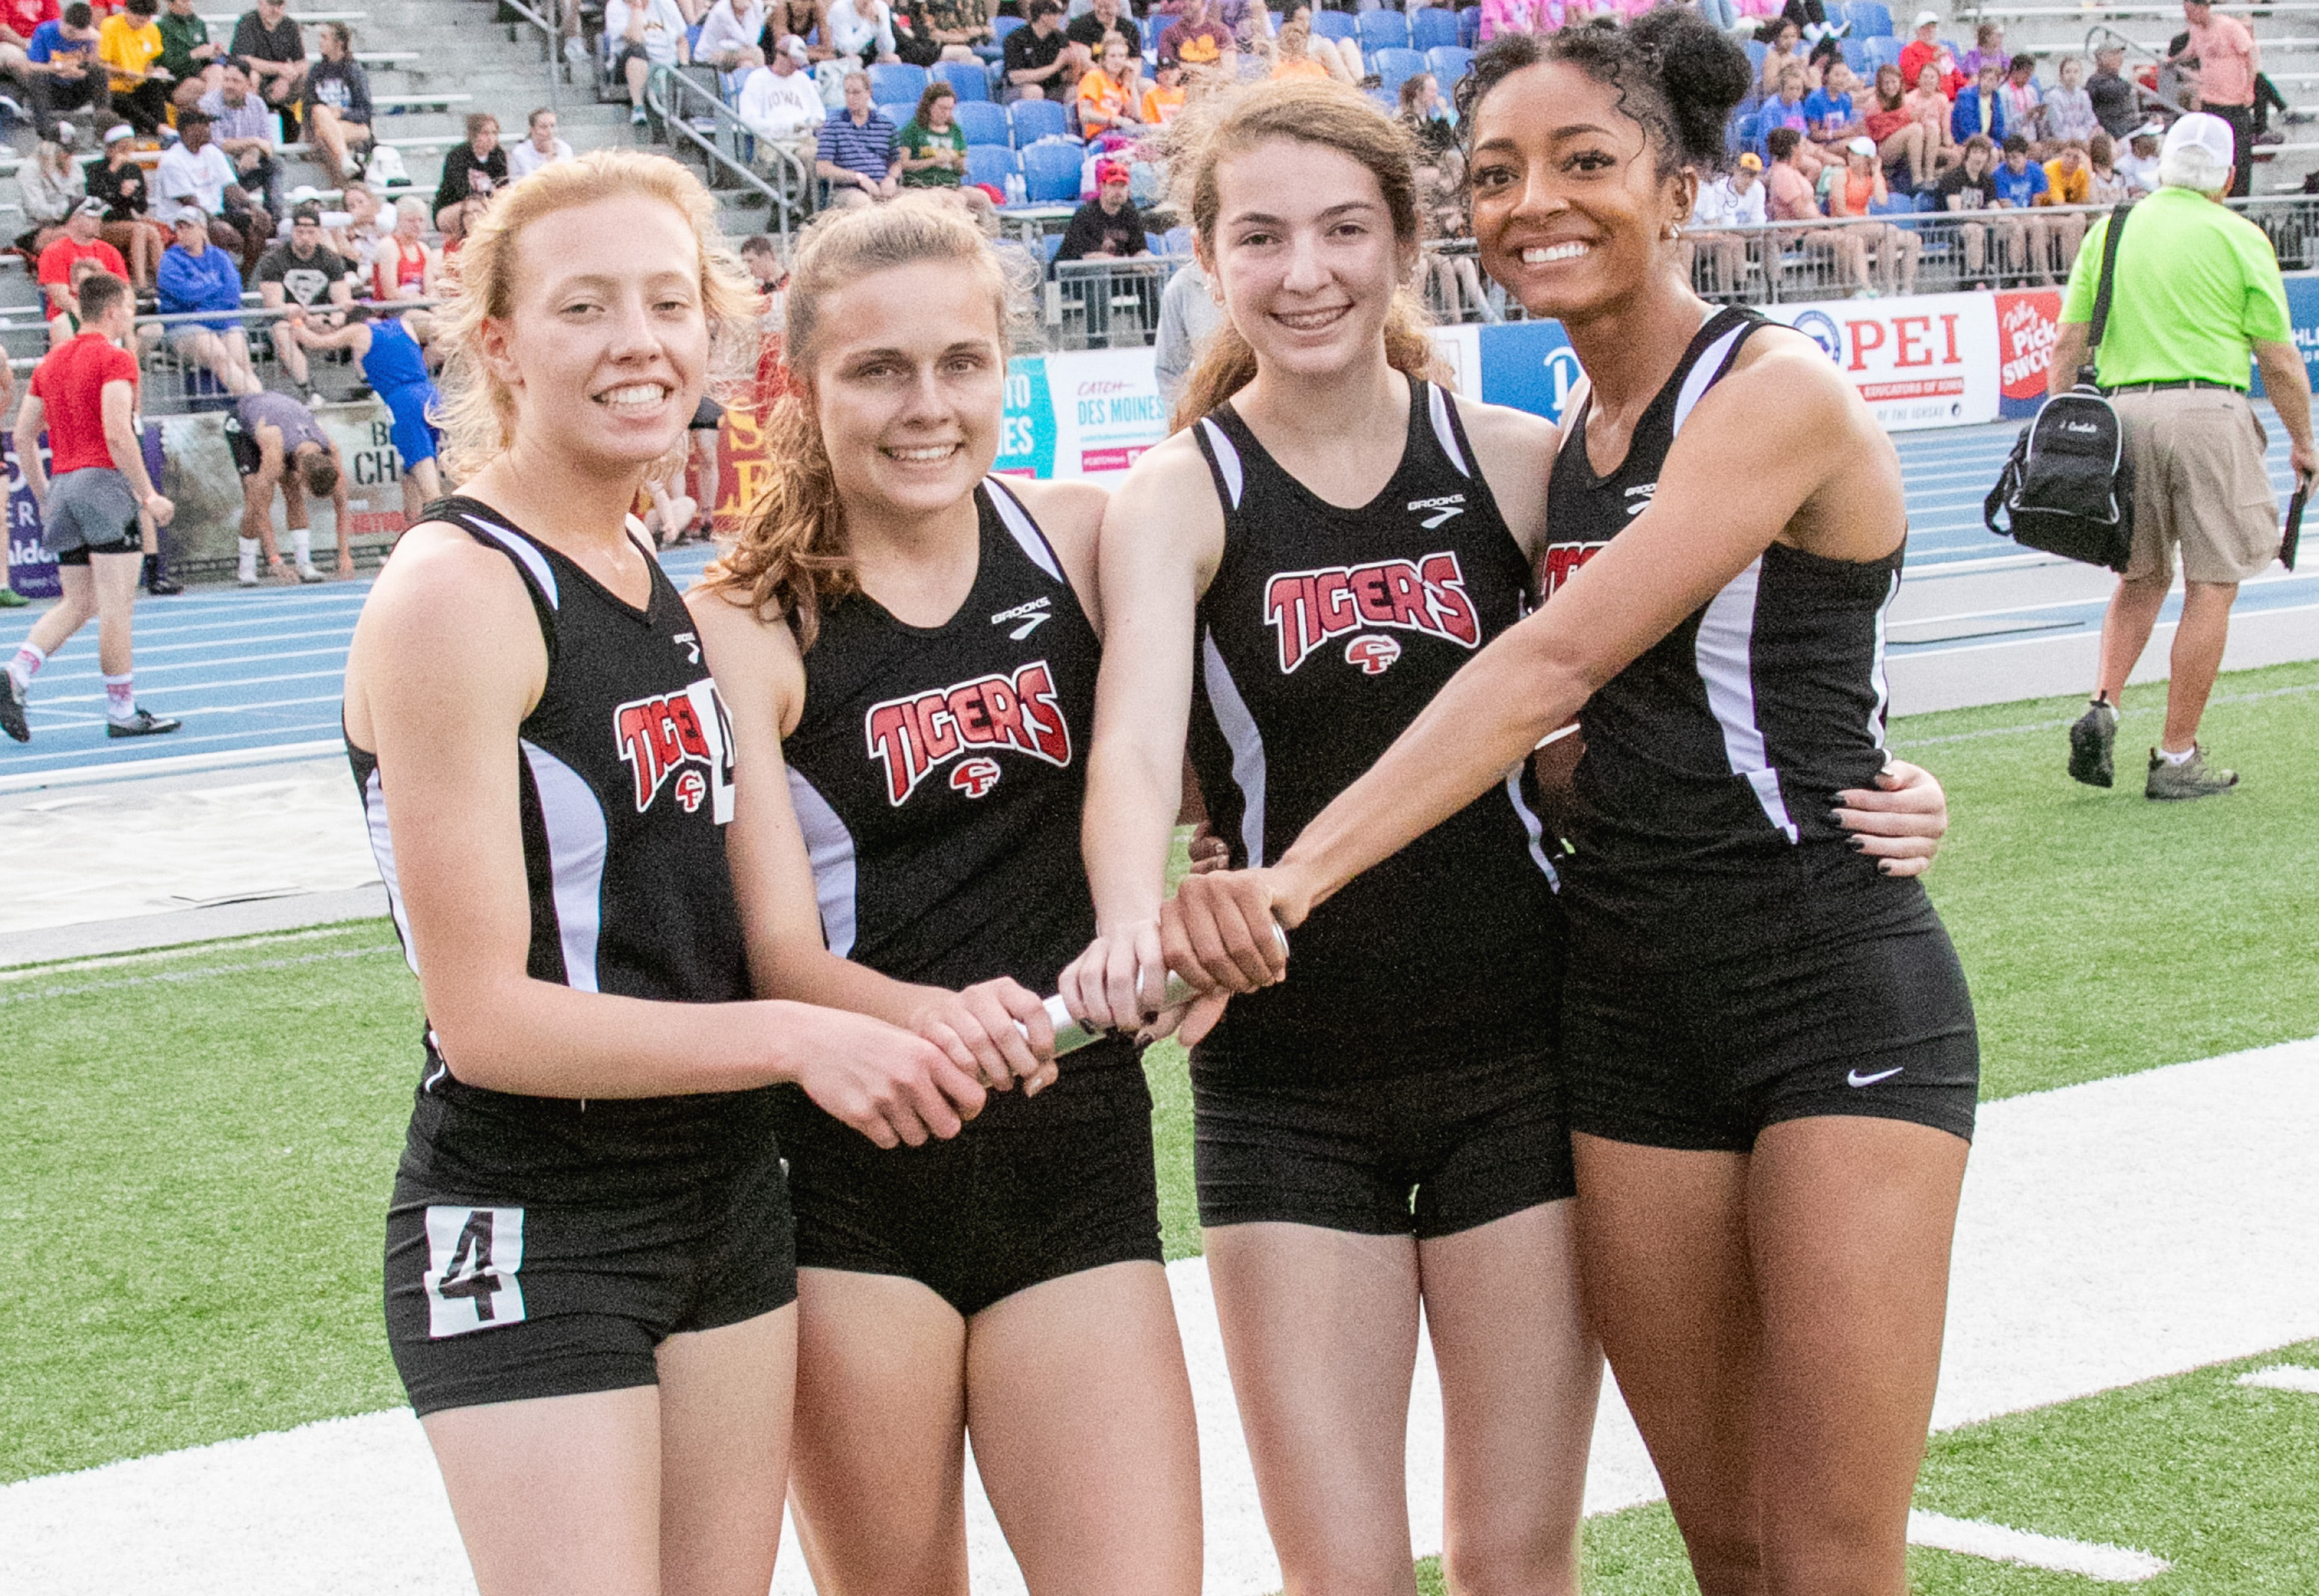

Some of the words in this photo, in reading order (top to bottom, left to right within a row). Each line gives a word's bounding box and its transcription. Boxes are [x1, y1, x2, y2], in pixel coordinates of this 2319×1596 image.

[1845, 313, 1962, 372] PEI
[2012, 317, 2056, 357] Pick
[1077, 400, 1105, 425] DES
[1111, 394, 1165, 419] MOINES
[997, 416, 1035, 458] ES
[354, 450, 398, 485] CH
[1408, 493, 1464, 511] BROOKS
[991, 596, 1050, 625] BROOKS
[1263, 550, 1481, 674] TIGERS
[613, 688, 712, 813] TIGE
[865, 659, 1072, 807] TIGERS
[438, 1210, 502, 1322] 4
